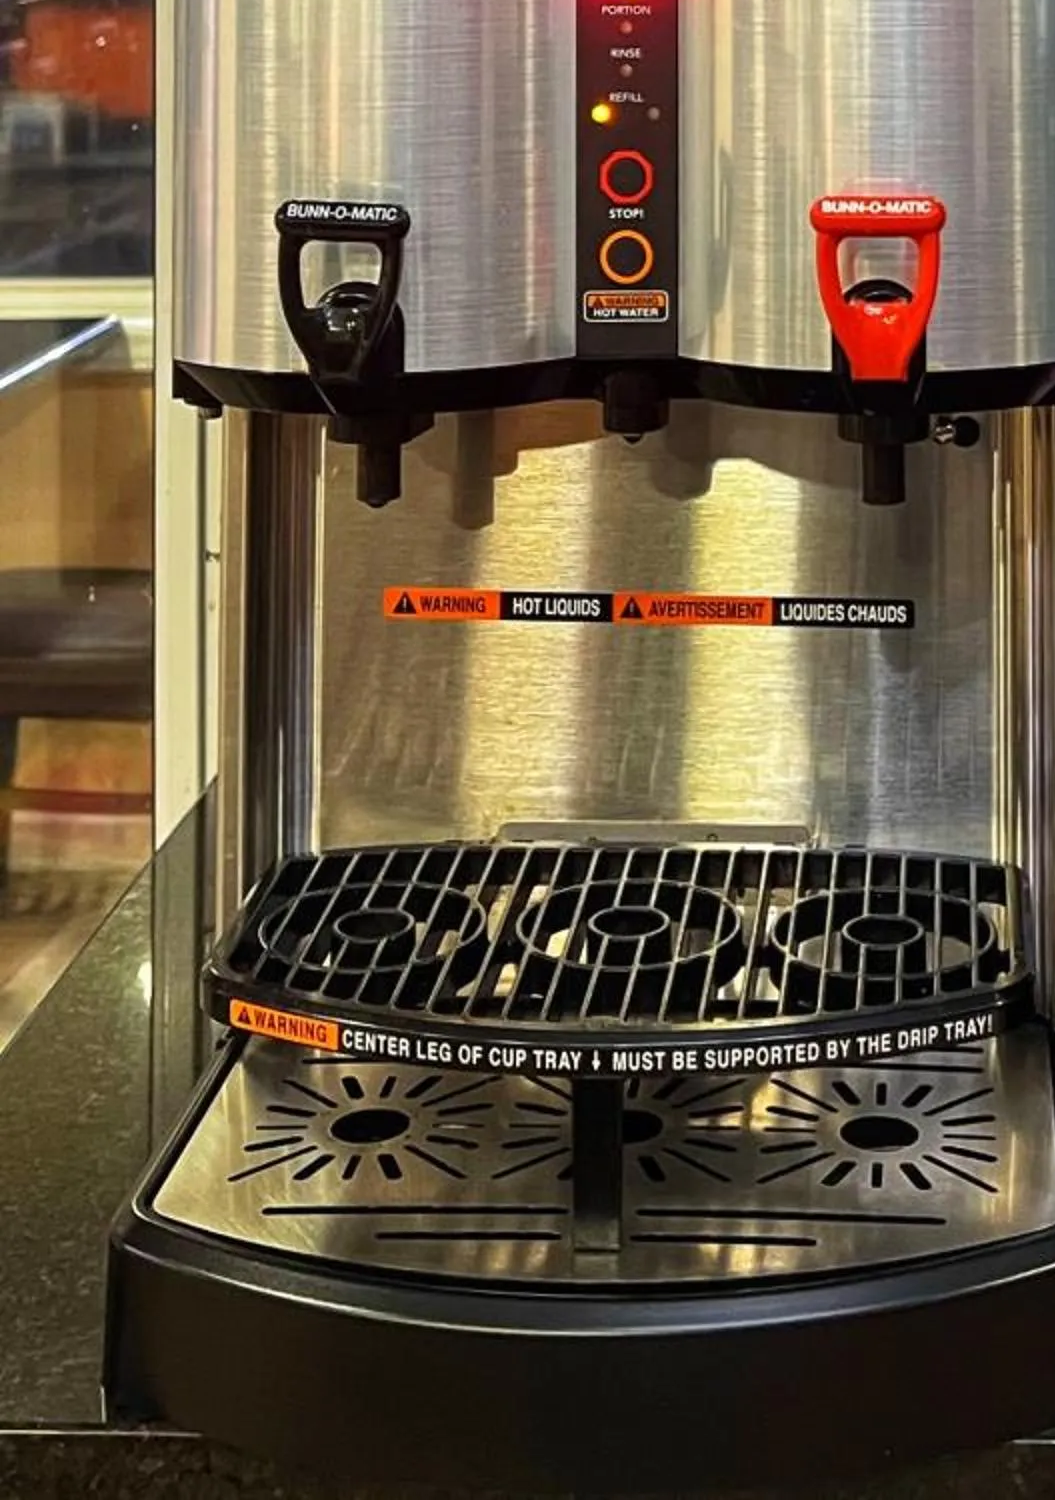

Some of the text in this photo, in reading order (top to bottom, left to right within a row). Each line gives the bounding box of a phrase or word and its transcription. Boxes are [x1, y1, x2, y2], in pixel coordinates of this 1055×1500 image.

[601, 5, 652, 15] PORTION
[610, 47, 642, 59] RINSE
[608, 92, 645, 103] REFILL
[286, 203, 398, 221] BUNN-O-MATIC
[608, 207, 646, 219] STOP!
[820, 200, 933, 214] BUNN-O-MATIC
[604, 296, 659, 306] WARNING
[593, 307, 659, 317] HOT WATER
[419, 595, 908, 623] WARNING HOT LIQUIDS AVERTISSEMENT LIQUIDES CHAUDS
[253, 1011, 994, 1071] WARNING CENTER LEG OF CUP TRAY MUST BE SUPPORTED BY THE DRIP TRAY!
